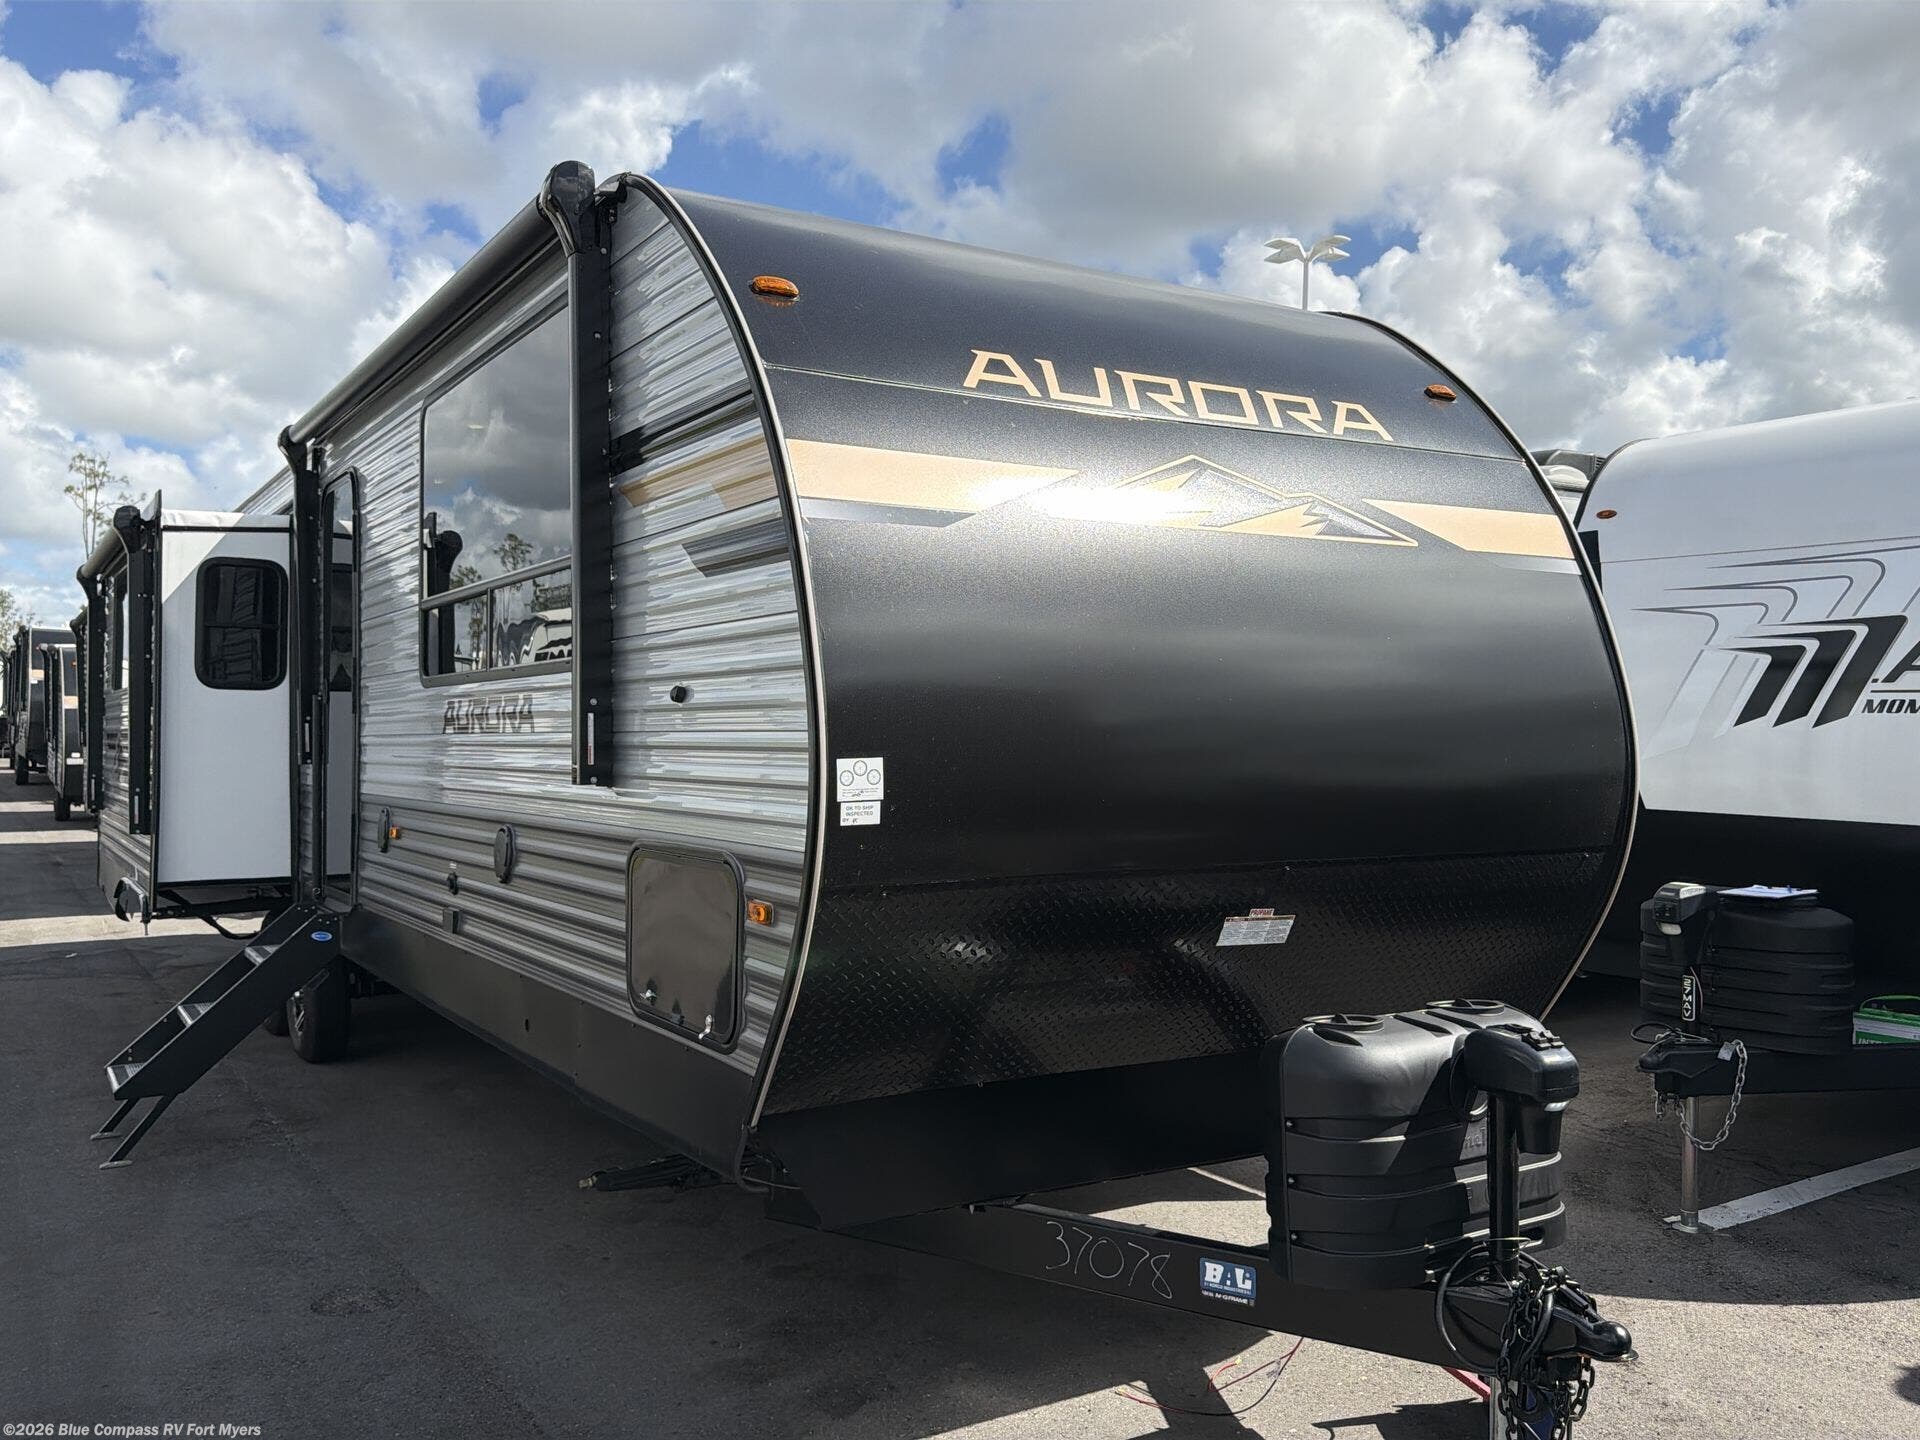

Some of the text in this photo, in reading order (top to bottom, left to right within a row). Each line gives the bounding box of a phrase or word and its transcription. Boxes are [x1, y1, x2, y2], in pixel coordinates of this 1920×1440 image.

[962, 348, 1394, 442] AURORA
[442, 693, 535, 734] AURORA
[1861, 698, 1920, 714] MOM
[1045, 1221, 1173, 1299] 37078
[1204, 1261, 1253, 1290] BAL
